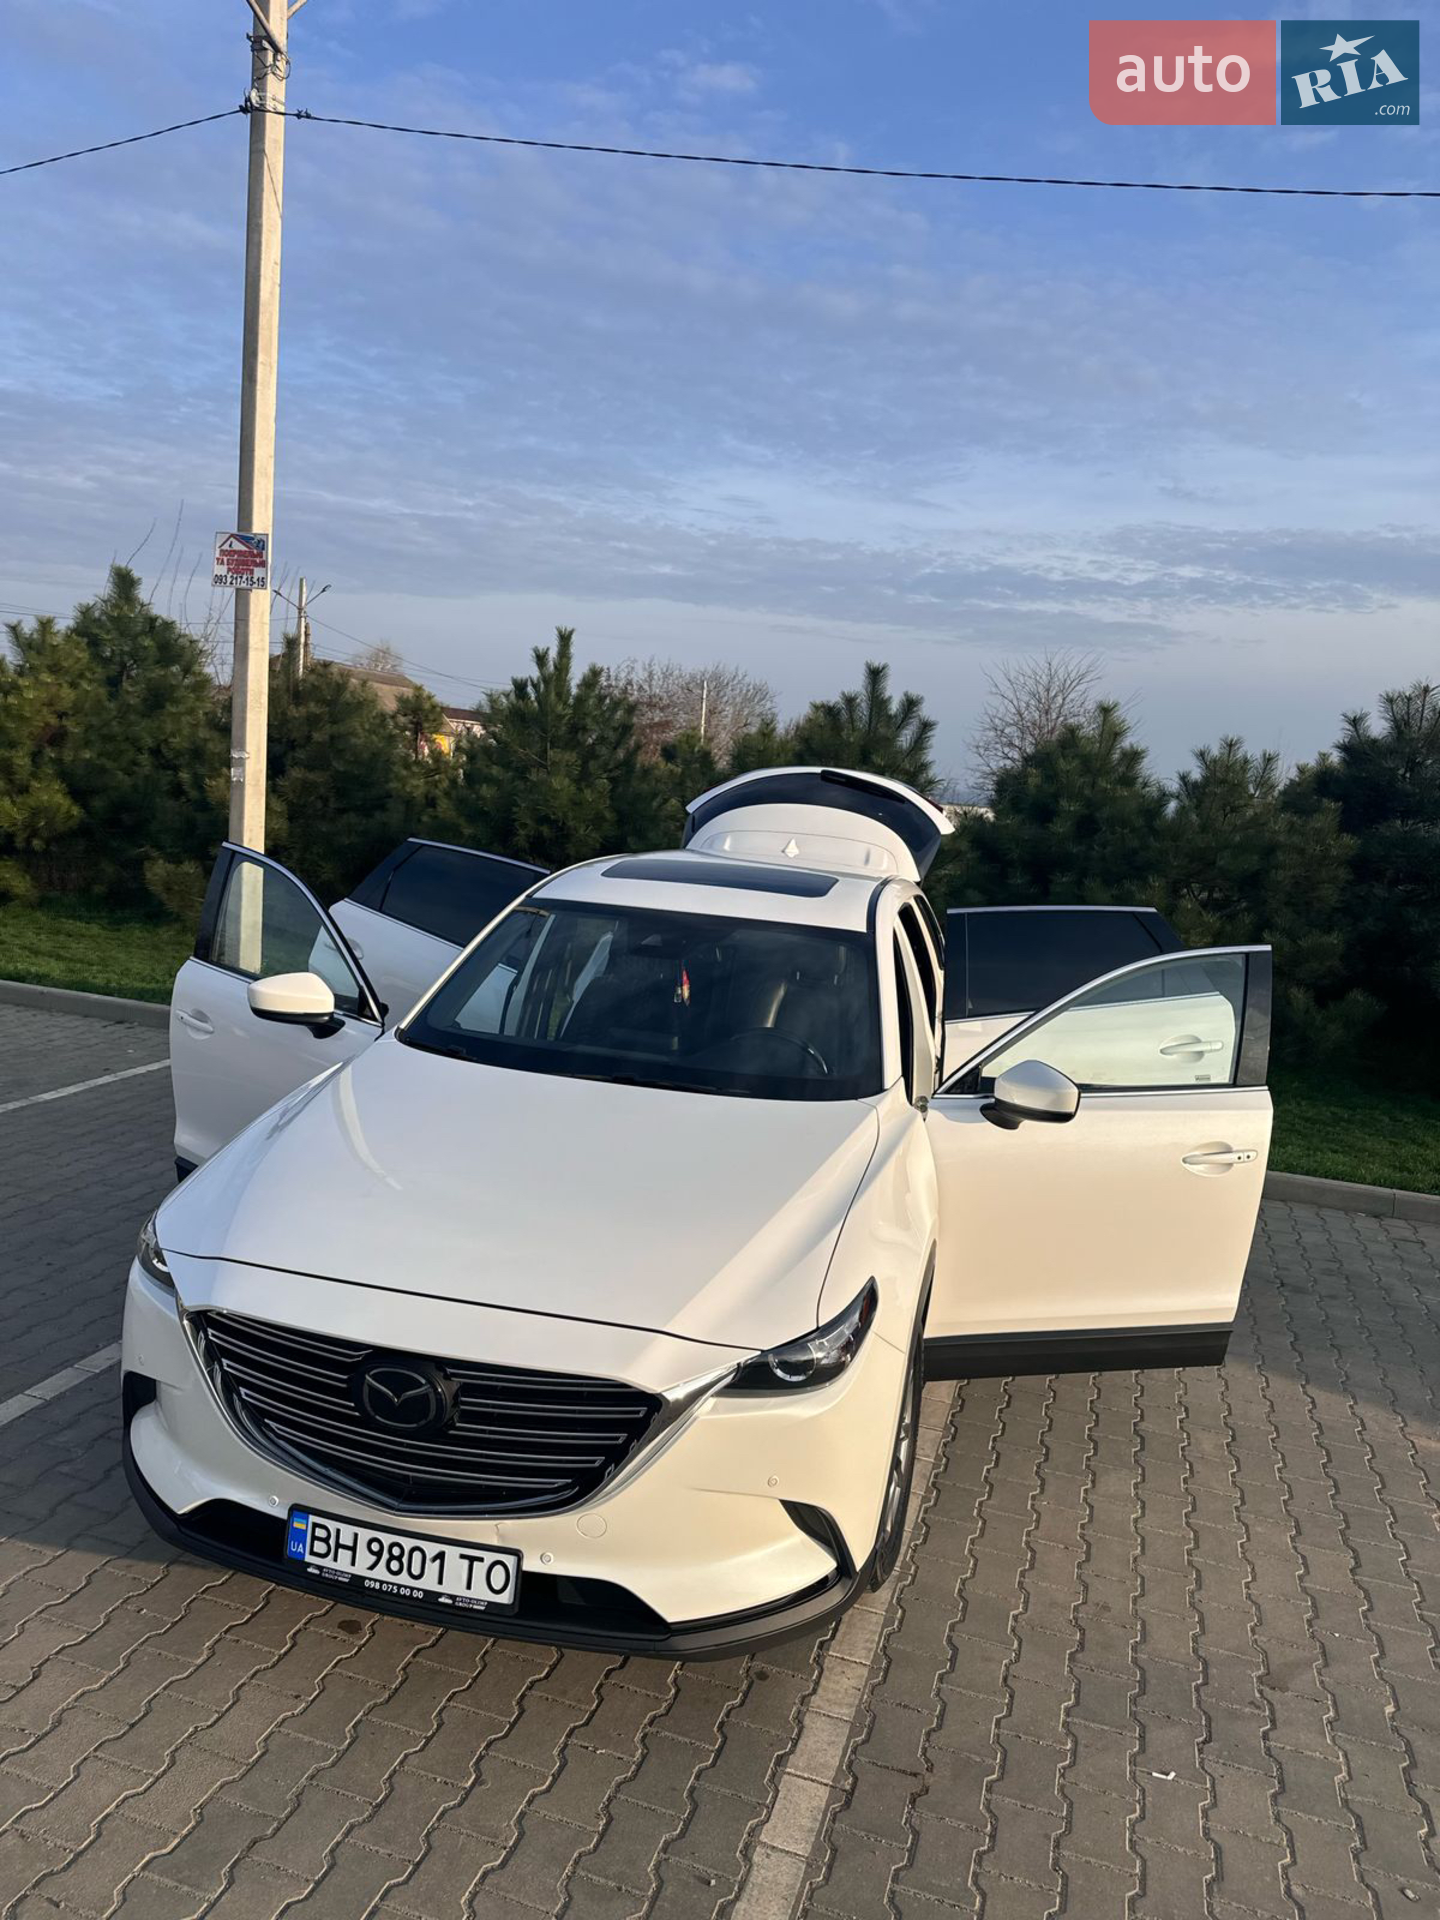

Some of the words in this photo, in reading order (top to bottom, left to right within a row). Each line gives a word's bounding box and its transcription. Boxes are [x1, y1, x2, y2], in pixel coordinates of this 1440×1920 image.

[214, 574, 227, 584] 093
[229, 576, 265, 587] 217-15-15
[290, 1540, 304, 1555] UA
[309, 1521, 359, 1567] BH
[365, 1536, 446, 1586] 9801
[459, 1553, 511, 1596] TO
[364, 1579, 380, 1590] 098
[382, 1583, 398, 1593] 075
[400, 1587, 411, 1596] 00
[412, 1589, 424, 1599] 00
